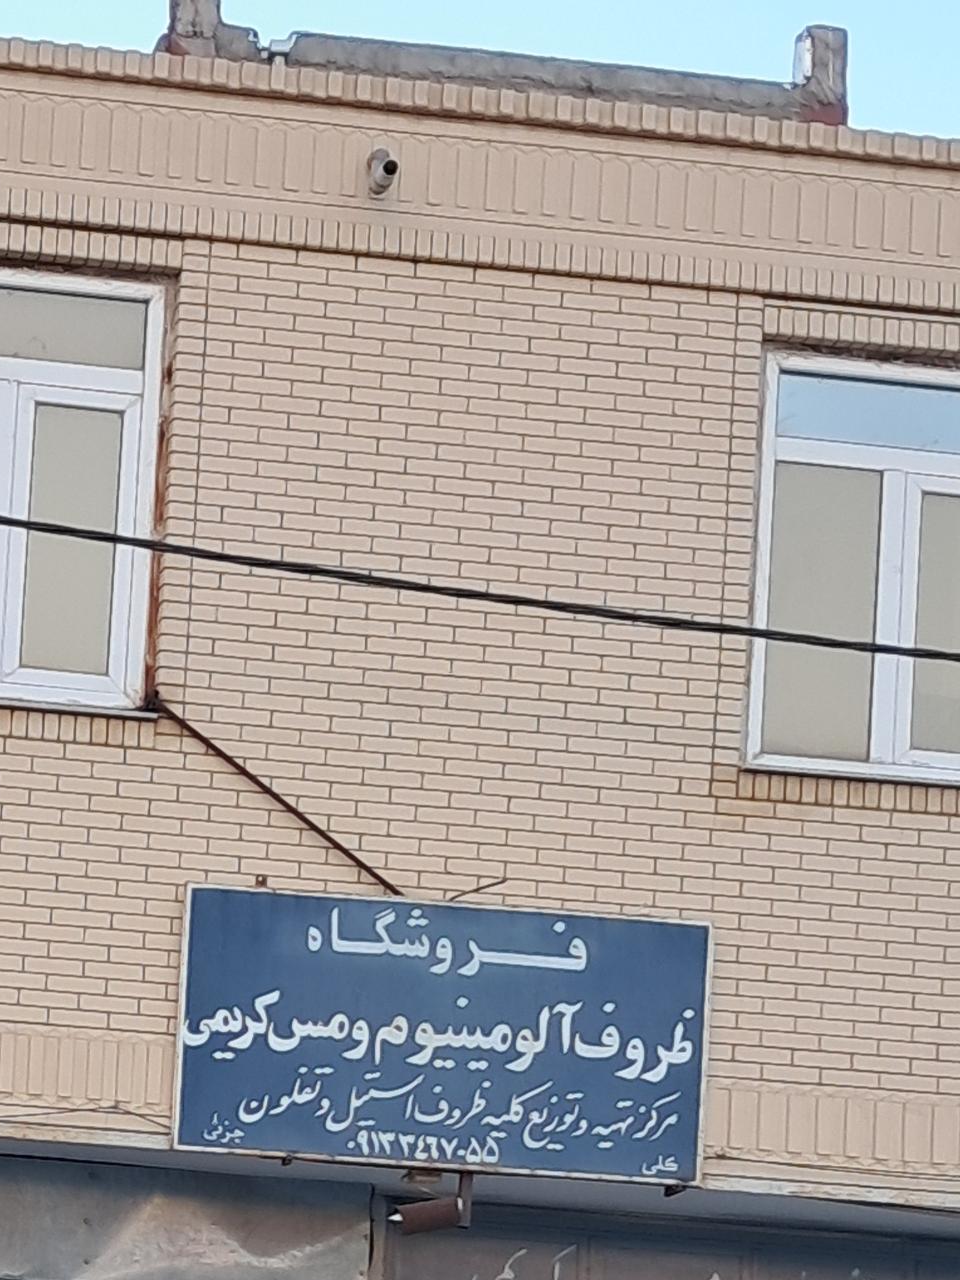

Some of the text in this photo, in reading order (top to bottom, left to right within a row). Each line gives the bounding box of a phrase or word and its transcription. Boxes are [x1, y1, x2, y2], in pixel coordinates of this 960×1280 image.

[307, 906, 588, 977] فروشگاه
[183, 990, 696, 1083] ظروف آلومینیوم و مس کریمی
[238, 1066, 682, 1150] مرکز تهیه و توزیع کلیه ظروف استیل و تفلون
[641, 1154, 679, 1176] کلی
